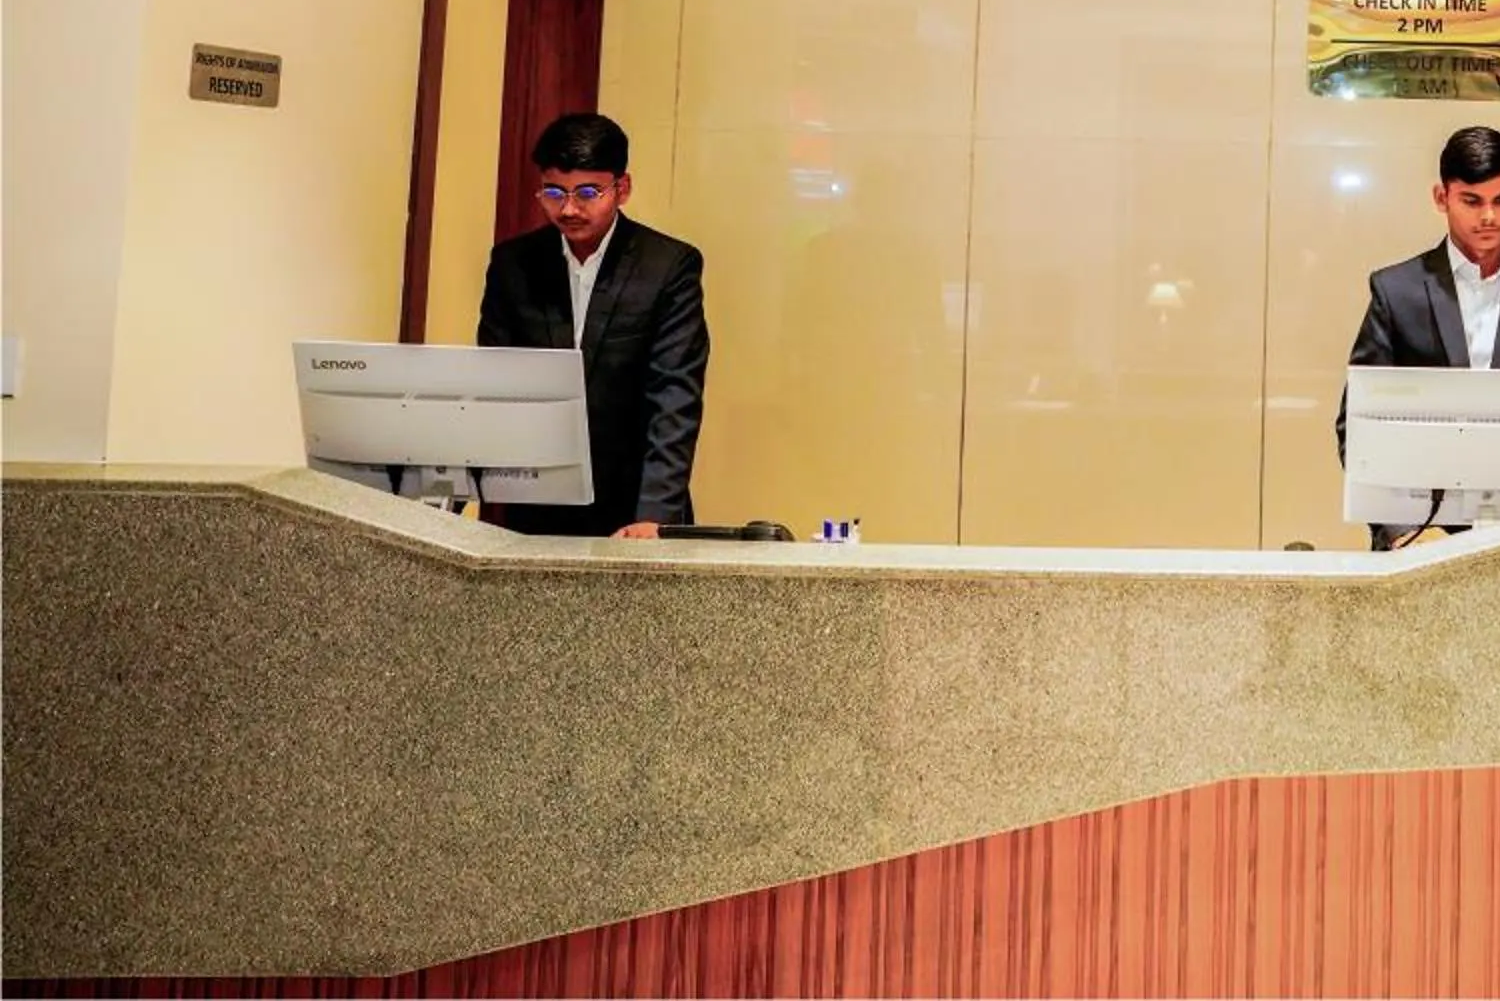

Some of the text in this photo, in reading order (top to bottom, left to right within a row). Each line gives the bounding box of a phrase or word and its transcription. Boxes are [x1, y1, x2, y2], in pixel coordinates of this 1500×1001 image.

[1397, 18, 1443, 33] 2 PM
[1342, 53, 1401, 70] CHE
[1451, 55, 1496, 72] TIME
[208, 76, 263, 98] RESERVED
[311, 358, 367, 371] Lenovo
